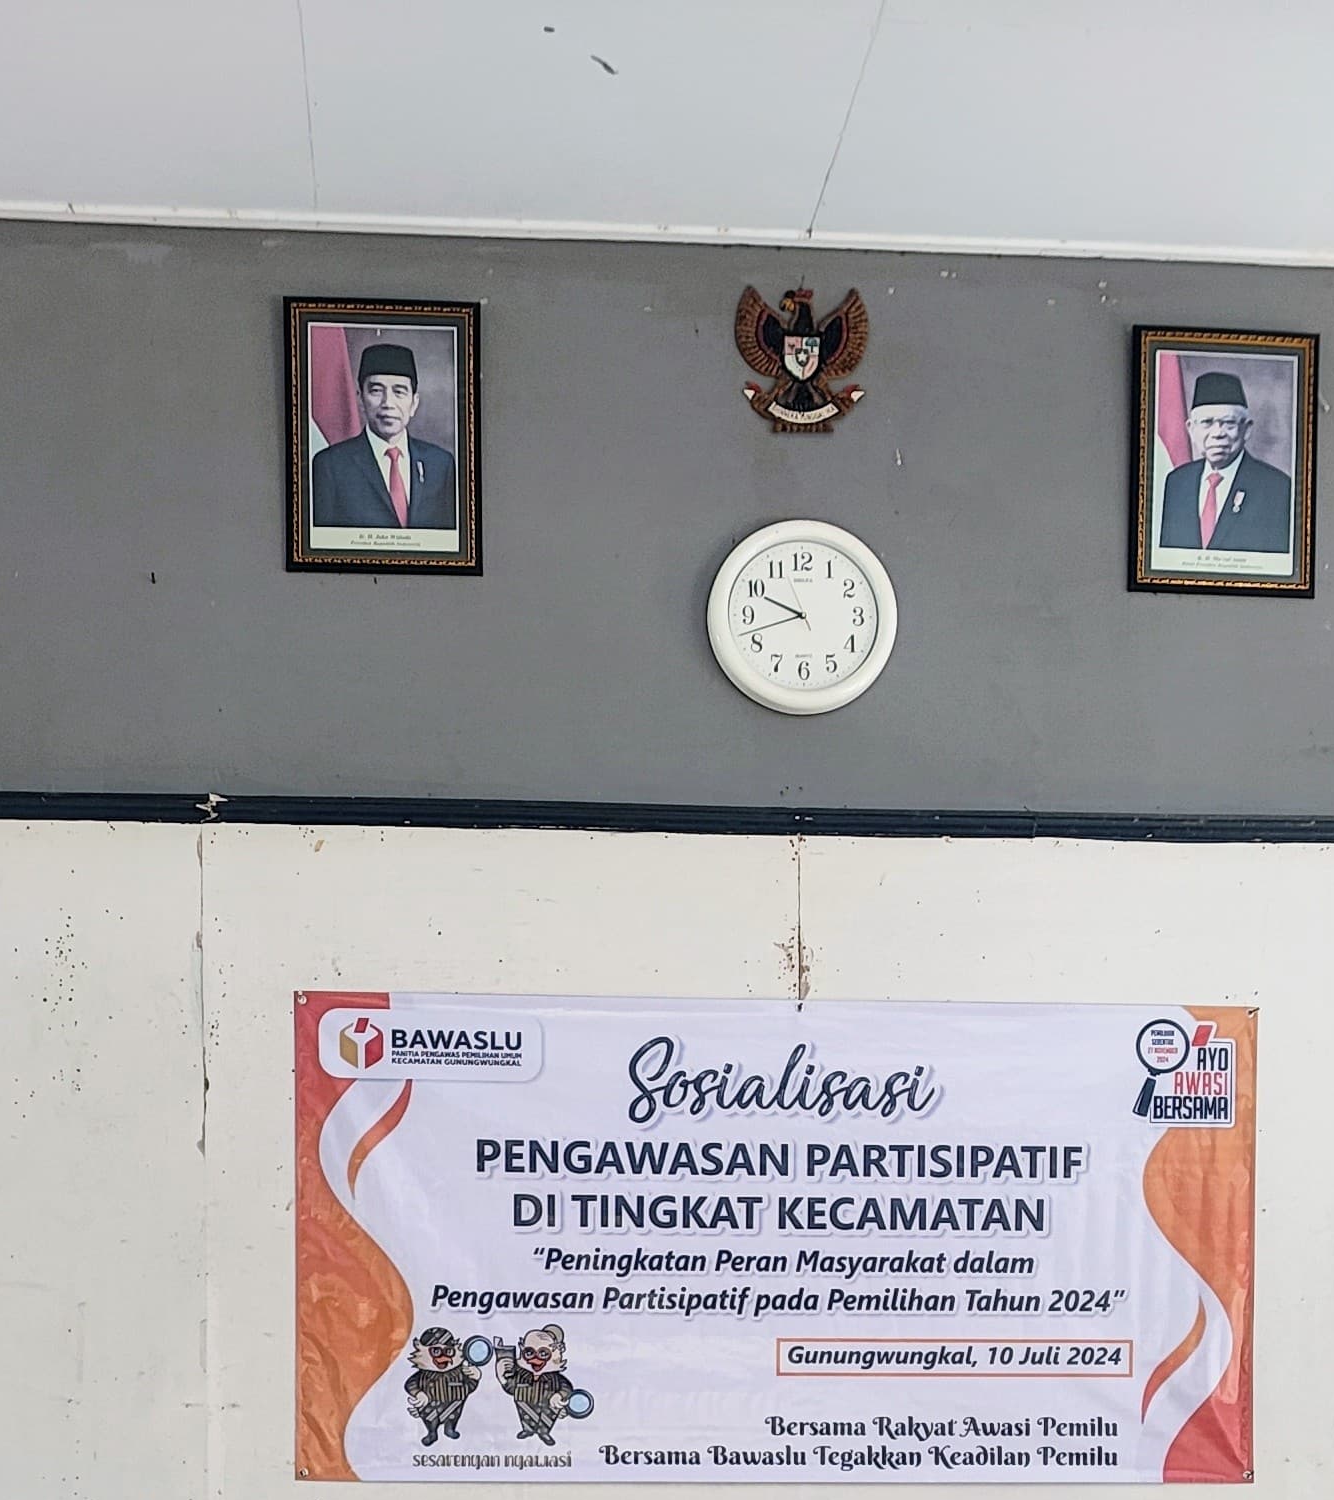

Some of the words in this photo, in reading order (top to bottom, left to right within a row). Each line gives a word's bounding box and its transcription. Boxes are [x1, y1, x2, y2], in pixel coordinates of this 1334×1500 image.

[768, 560, 785, 578] 11
[791, 552, 813, 571] 12
[825, 560, 834, 579] 1
[748, 579, 765, 597] 10
[843, 579, 855, 598] 2
[742, 605, 755, 625] 9
[852, 607, 864, 626] 3
[750, 633, 763, 652] 8
[843, 634, 856, 653] 4
[770, 654, 783, 672] 7
[798, 661, 810, 680] 6
[825, 653, 838, 673] 5
[391, 1029, 522, 1050] BAWASLU
[444, 1058, 522, 1067] GUNUNGWUNGKAL
[1197, 1047, 1228, 1071] AYO
[628, 1036, 935, 1123] Sosialisasi
[1174, 1072, 1227, 1095] AWASI
[1153, 1096, 1228, 1119] BERSAMA
[476, 1139, 789, 1176] PENGAWASAN
[806, 1143, 1082, 1179] PARTISIPATIF
[513, 1193, 556, 1228] DI
[571, 1194, 763, 1230] TINGKAT
[778, 1197, 1045, 1231] KECAMATAN
[715, 1249, 788, 1273] Peran
[796, 1250, 946, 1279] Masyarakat
[953, 1250, 1034, 1274] dalam
[431, 1284, 594, 1314] Pengawasan
[602, 1286, 750, 1316] Partisipatif
[754, 1287, 818, 1317] pada
[827, 1287, 955, 1312] Pemilihan
[965, 1288, 1040, 1312] Tahun
[787, 1346, 978, 1369] Gunungwungkal,
[987, 1346, 1013, 1365] 10
[1018, 1346, 1060, 1366] Juli
[1067, 1347, 1122, 1366] 2024
[765, 1416, 866, 1436] Bersama
[872, 1416, 957, 1441] Rakyat
[960, 1416, 1031, 1437] Awasi
[1037, 1416, 1118, 1437] Pemilu
[412, 1453, 501, 1470] sesarengan
[504, 1450, 572, 1470] ngawasi
[599, 1444, 701, 1465] Bersama
[707, 1444, 806, 1465] Bawaslu
[812, 1445, 922, 1471] Tegakkan
[927, 1445, 1031, 1469] Keadilan
[1037, 1445, 1118, 1466] Pemilu
